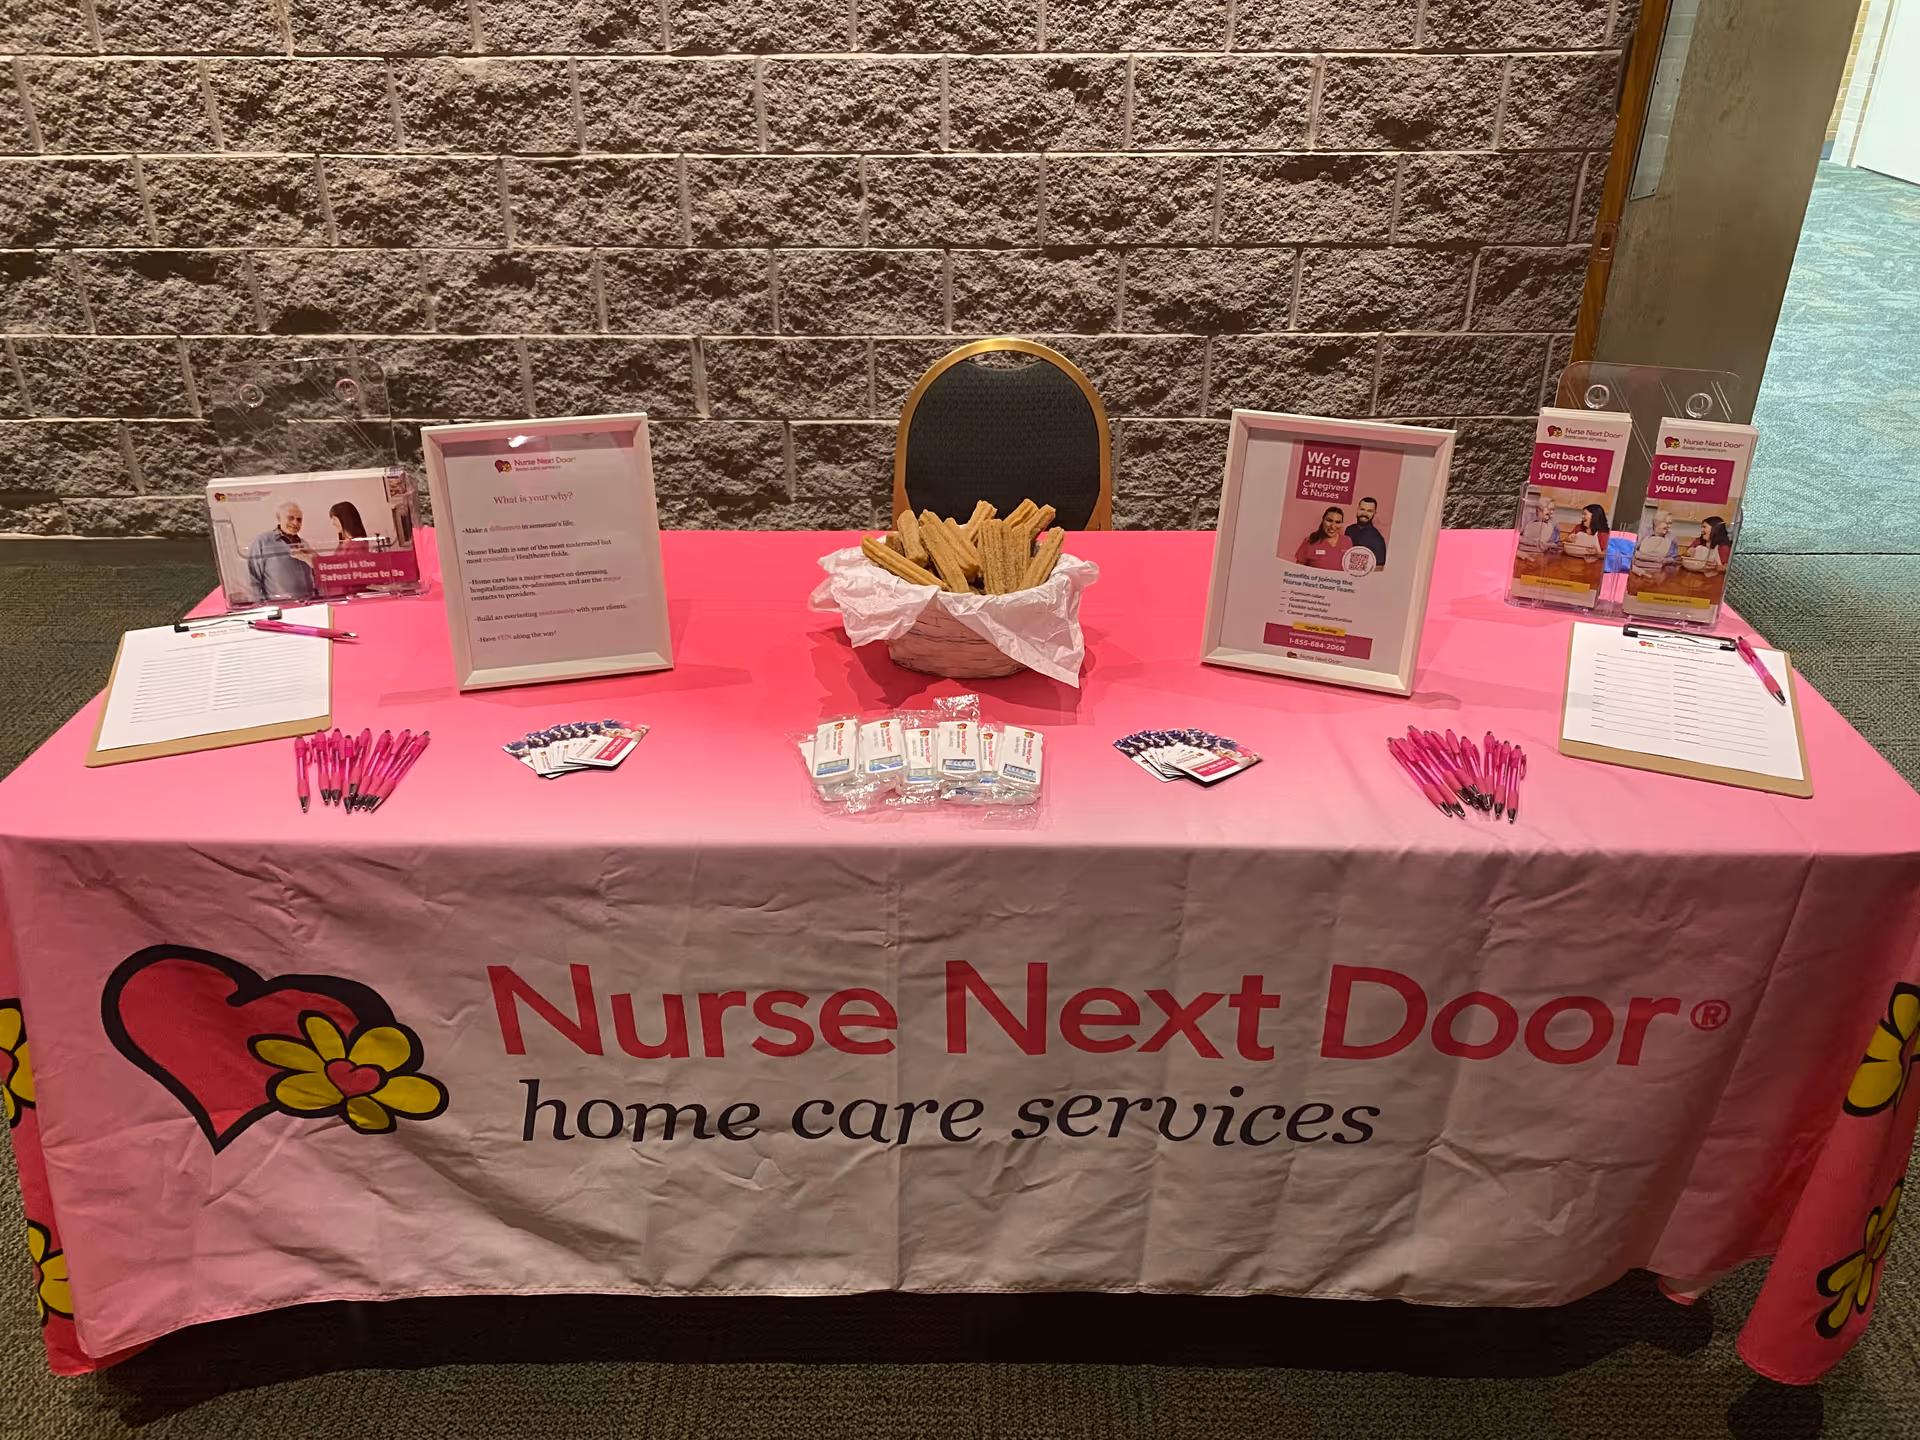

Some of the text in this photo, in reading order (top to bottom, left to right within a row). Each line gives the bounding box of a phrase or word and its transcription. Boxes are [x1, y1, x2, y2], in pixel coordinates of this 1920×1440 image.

[1565, 427, 1585, 436] Nurse
[1585, 429, 1603, 437] Next
[1682, 438, 1704, 446] Nurse
[514, 459, 535, 467] Nurse
[537, 457, 555, 465] Next
[1542, 450, 1561, 460] Get
[1562, 452, 1585, 462] back
[1540, 460, 1596, 474] doing what
[1659, 462, 1717, 475] Get back to
[1305, 464, 1351, 484] Hiring
[1538, 472, 1579, 483] you love
[1657, 473, 1715, 486] doing what
[1302, 479, 1349, 492] Caregivers
[1655, 484, 1698, 494] you love
[493, 491, 573, 504] What is your why?
[1301, 487, 1339, 499] & Nurses
[488, 547, 510, 555] Health
[516, 552, 550, 560] Healthcare
[318, 560, 376, 571] Home is the
[320, 573, 351, 582] Safest
[352, 571, 379, 580] Place
[391, 569, 405, 577] Be
[523, 574, 542, 582] major
[543, 572, 565, 580] impact
[1284, 571, 1310, 580] Benefits
[1283, 578, 1301, 586] Nurse
[1302, 581, 1318, 589] Next
[1319, 583, 1335, 591] Door
[471, 594, 497, 602] contacts
[505, 590, 537, 600] providers.
[503, 611, 538, 620] everlasting
[512, 632, 531, 640] along
[487, 963, 898, 1059] Nurse
[945, 960, 1281, 1061] Next
[519, 1078, 1381, 1146] home care services
